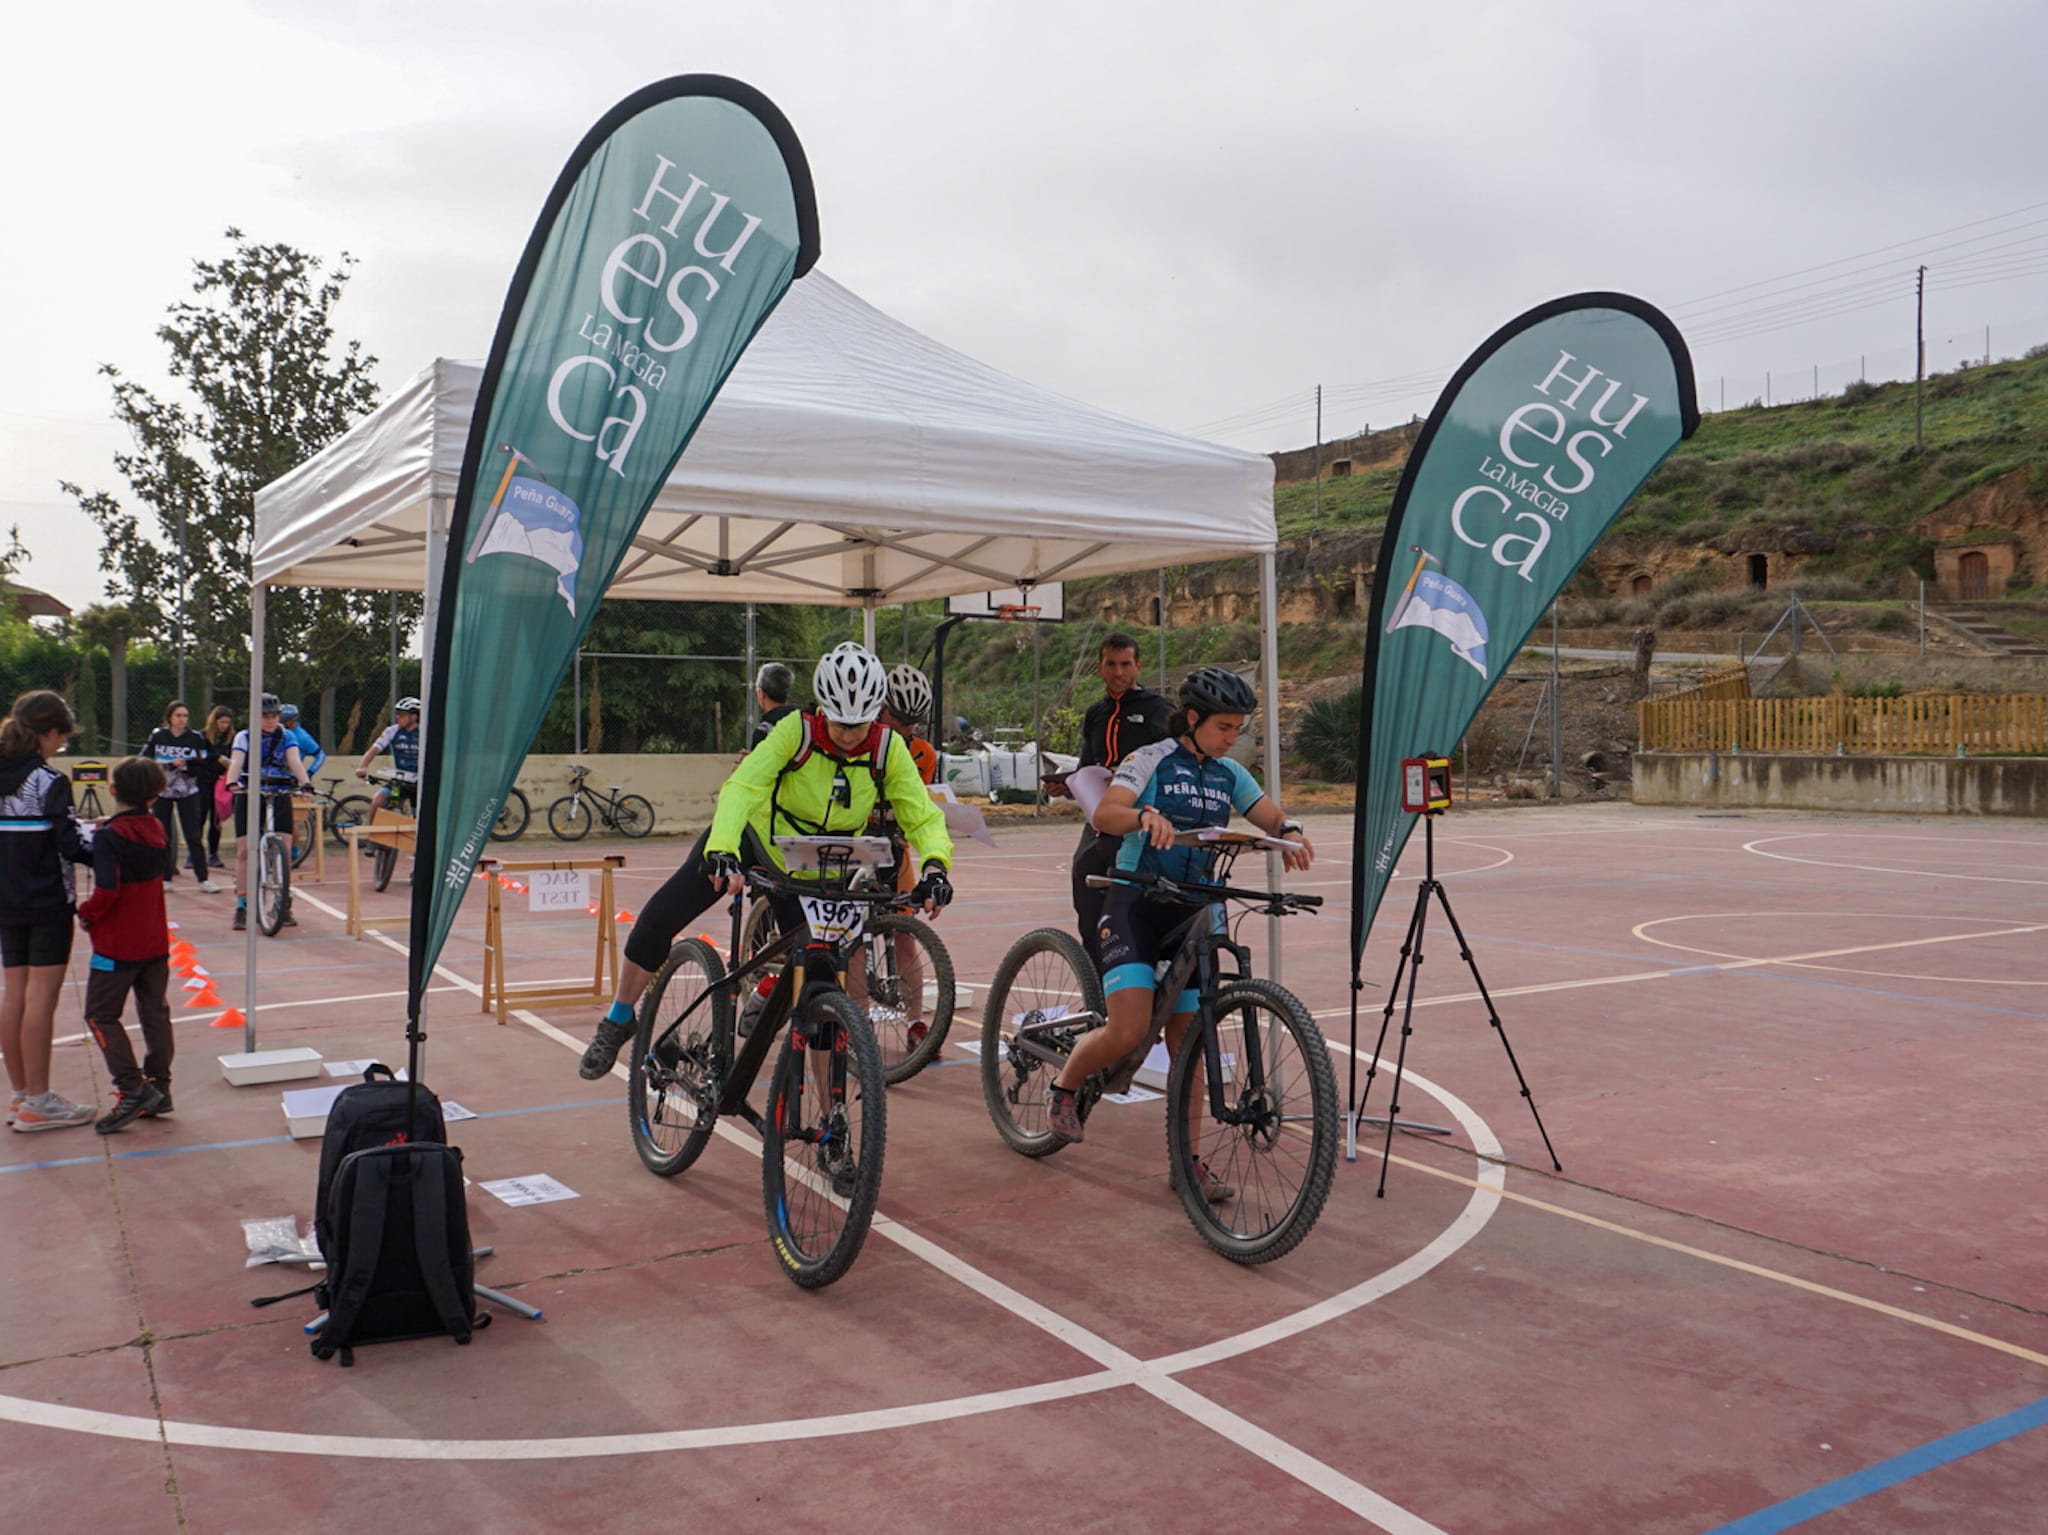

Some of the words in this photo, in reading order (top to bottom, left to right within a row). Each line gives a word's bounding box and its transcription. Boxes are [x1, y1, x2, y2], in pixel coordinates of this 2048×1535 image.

[513, 485, 543, 505] Peña
[545, 495, 576, 524] Guara
[155, 744, 198, 760] HUESCA
[1164, 781, 1199, 796] PEÑA
